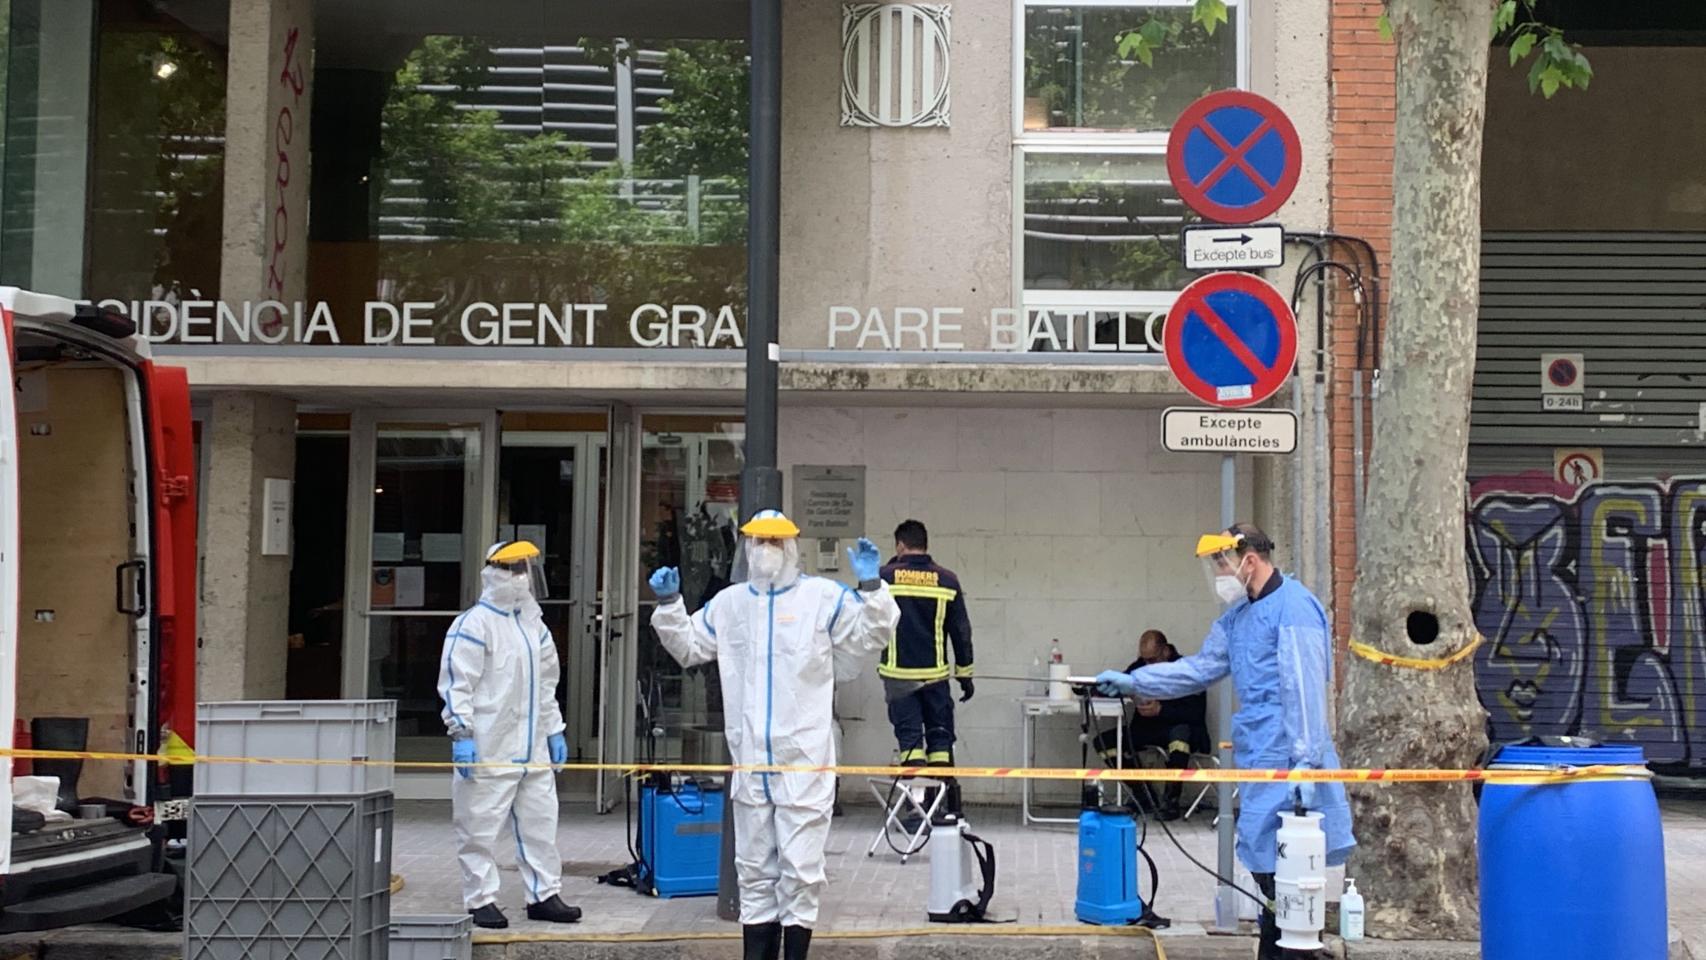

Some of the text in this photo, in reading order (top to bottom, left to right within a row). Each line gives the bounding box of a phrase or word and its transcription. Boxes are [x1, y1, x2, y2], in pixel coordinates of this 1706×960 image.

[1193, 248, 1274, 262] Excepte bus
[363, 301, 436, 345] DE
[460, 302, 607, 346] GENT
[629, 303, 754, 348] GRA
[827, 306, 964, 349] PARE
[1199, 415, 1262, 431] Excepte
[1180, 434, 1281, 448] ambulàncies
[894, 569, 939, 580] BOMBERS
